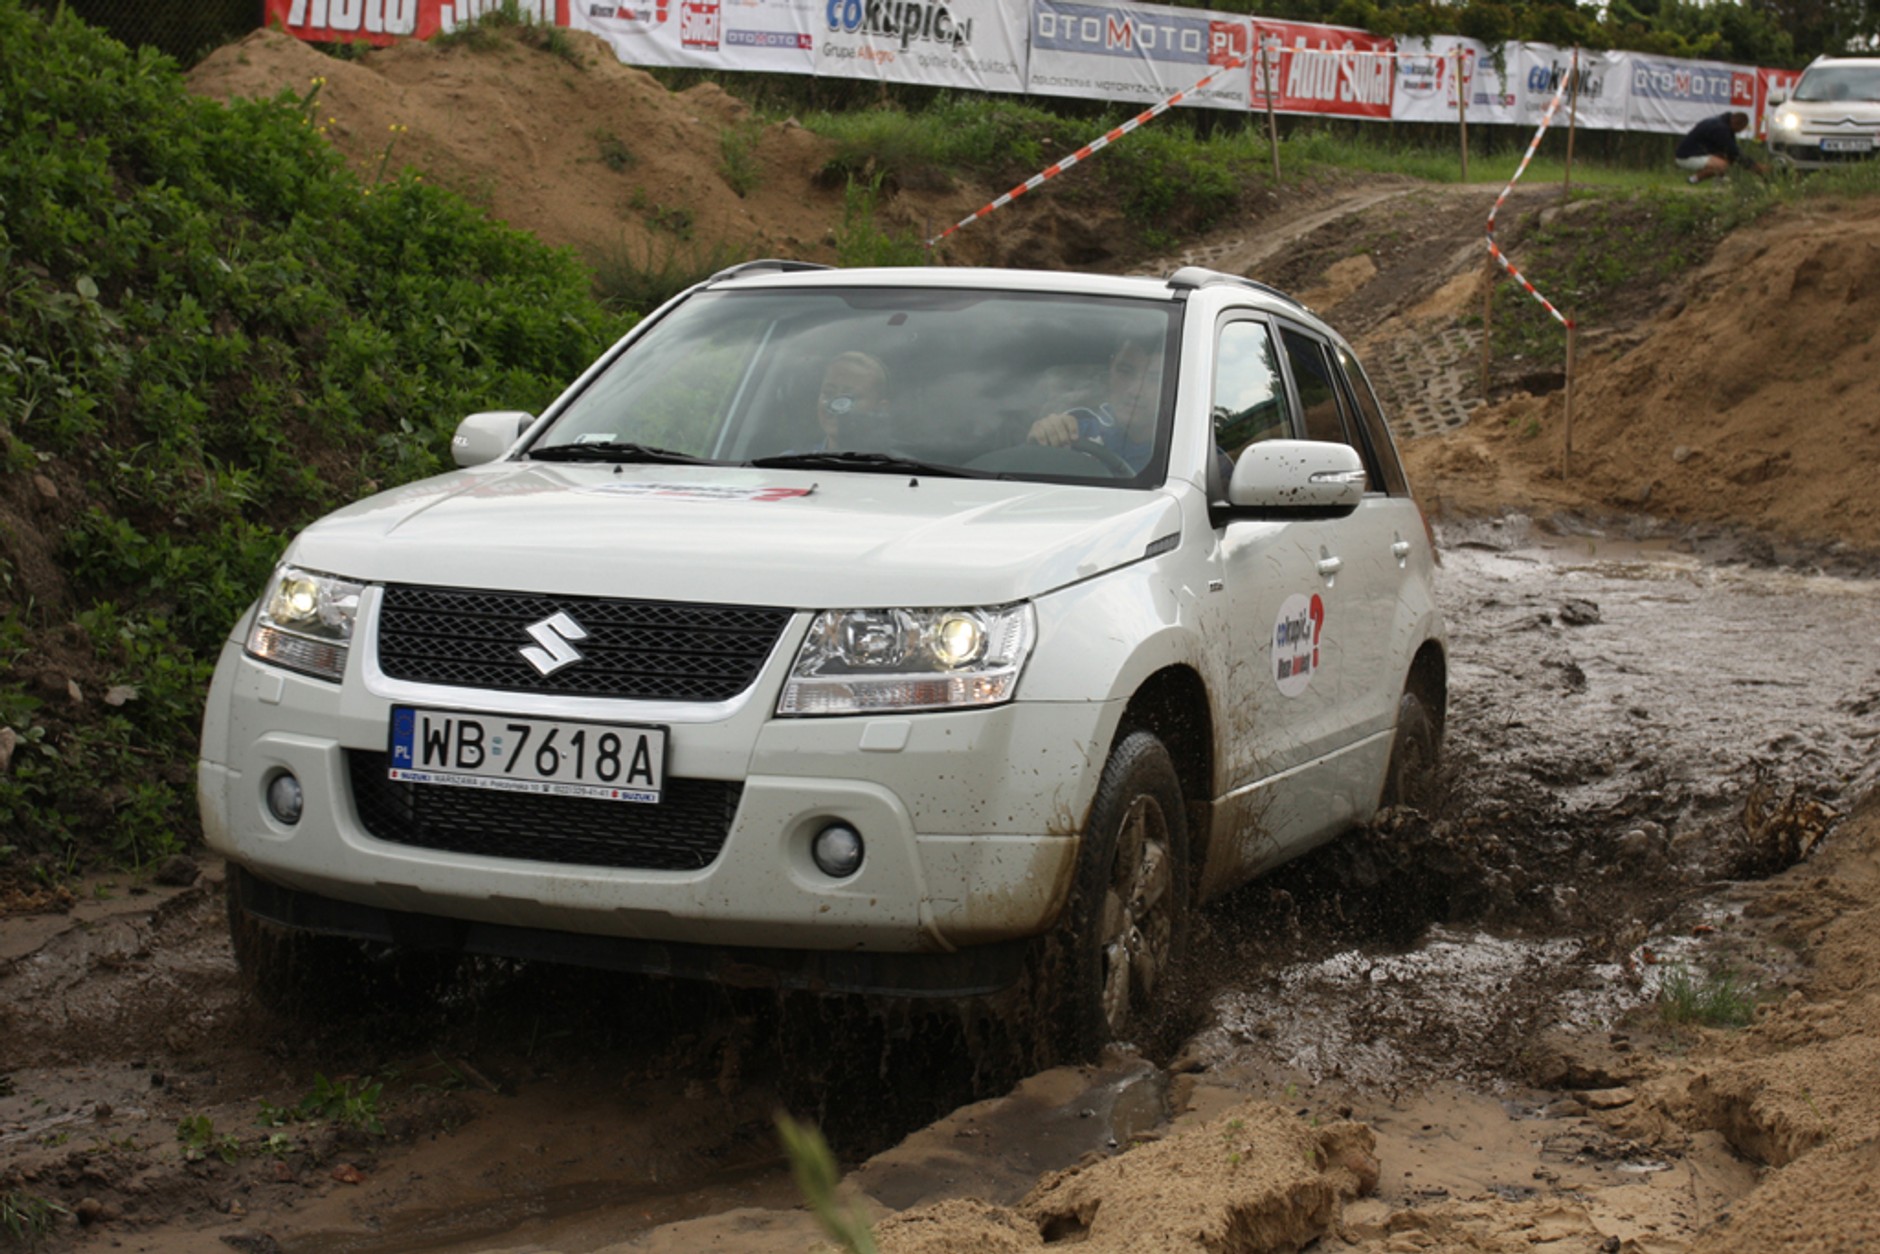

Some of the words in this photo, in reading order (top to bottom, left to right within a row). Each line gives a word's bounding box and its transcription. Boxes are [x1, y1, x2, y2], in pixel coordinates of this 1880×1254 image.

[1038, 12, 1242, 57] OTOMOTO.PL
[1285, 36, 1339, 100] Auto
[395, 745, 411, 760] PL
[422, 717, 485, 769] WB
[504, 723, 654, 786] 7618A
[401, 772, 431, 781] SUZUKI
[622, 791, 656, 801] SUZUKI
